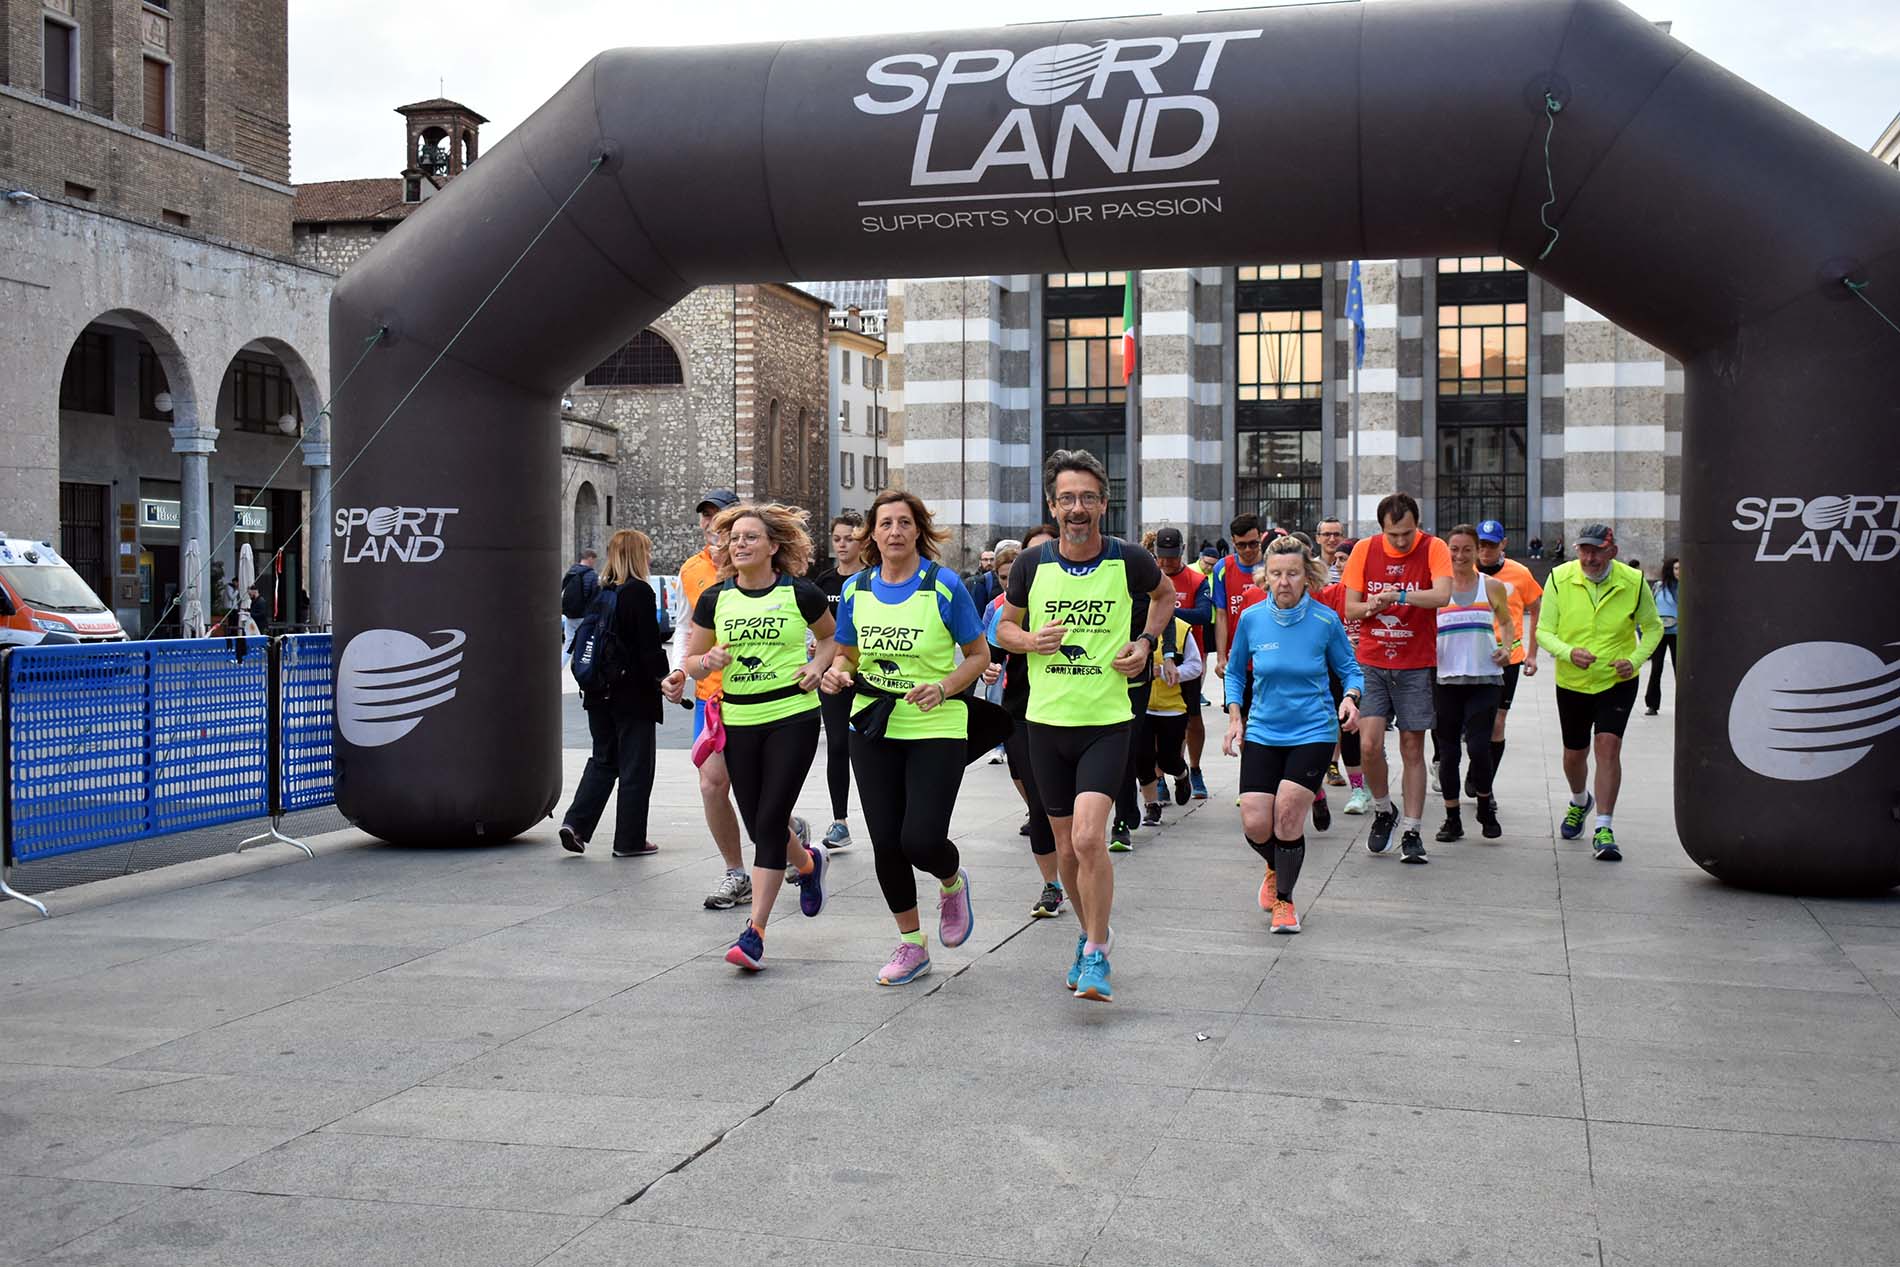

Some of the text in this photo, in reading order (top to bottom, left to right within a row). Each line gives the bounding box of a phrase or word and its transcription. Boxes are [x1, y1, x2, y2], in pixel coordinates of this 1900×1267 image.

[853, 29, 1264, 116] SPORT
[910, 95, 1220, 186] LAND
[862, 196, 1223, 233] SUPPORTS YOUR PASSION
[335, 506, 459, 537] SPORT
[343, 536, 445, 563] LAND
[1367, 581, 1421, 592] SPECIAL
[1044, 600, 1116, 613] SPORT
[724, 617, 789, 631] SPORT
[728, 628, 781, 642] LAND
[860, 625, 924, 641] SPORT
[863, 638, 914, 652] LAND
